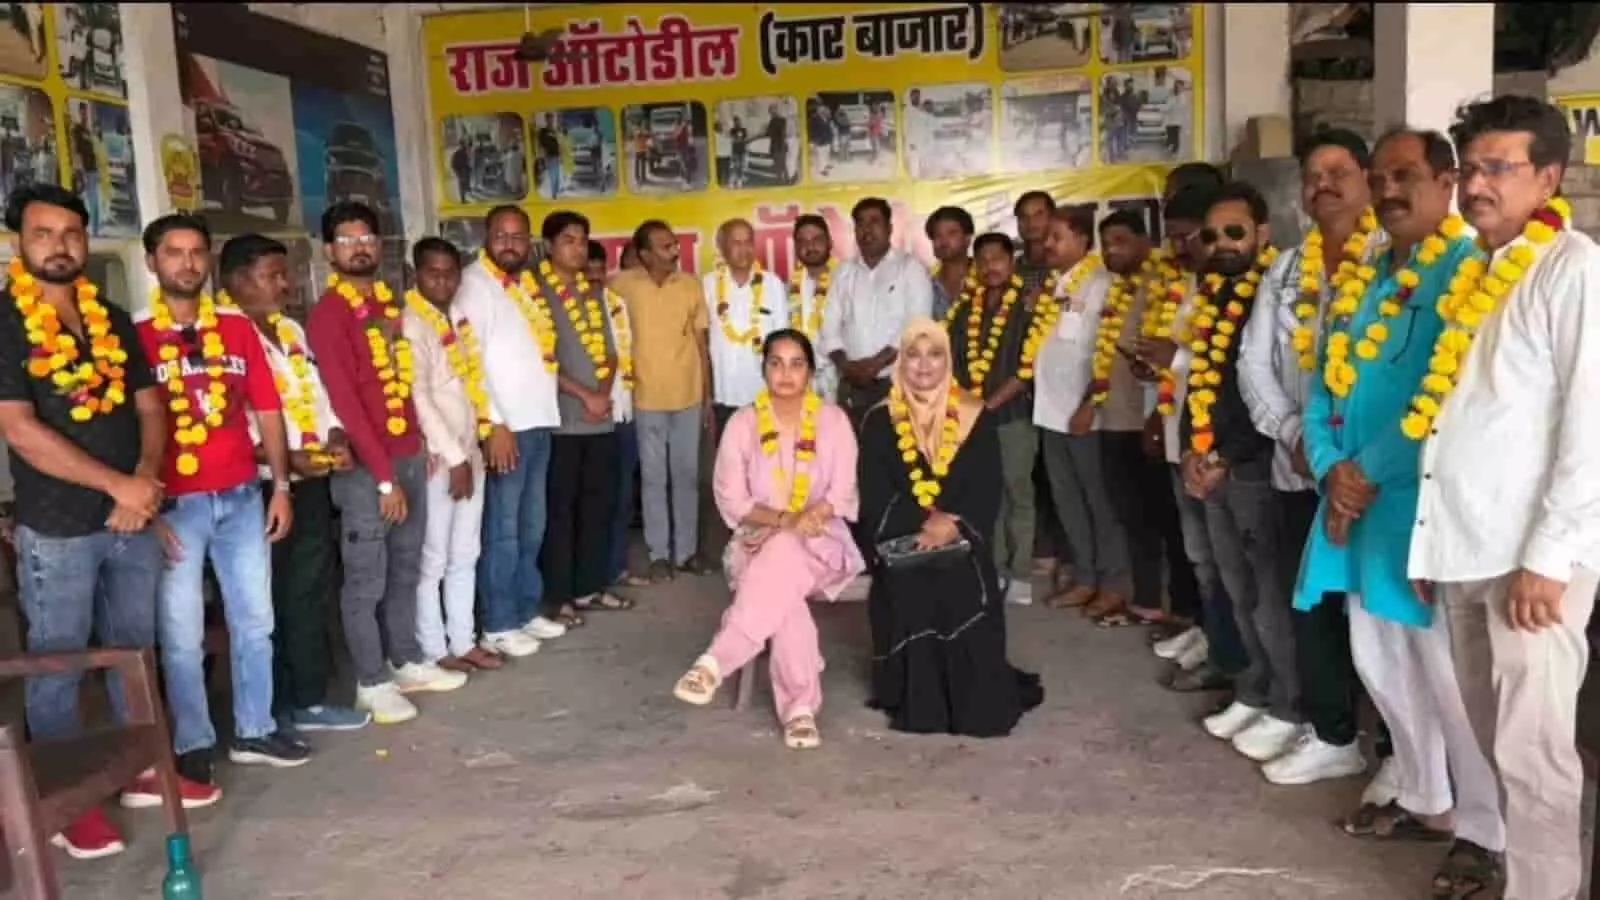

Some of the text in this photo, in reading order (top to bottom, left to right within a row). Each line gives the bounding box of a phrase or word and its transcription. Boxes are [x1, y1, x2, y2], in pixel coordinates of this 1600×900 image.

[445, 43, 530, 92] राज
[543, 17, 739, 86] ऑटोडील
[761, 12, 845, 75] (कार
[852, 3, 984, 59] बाजार)
